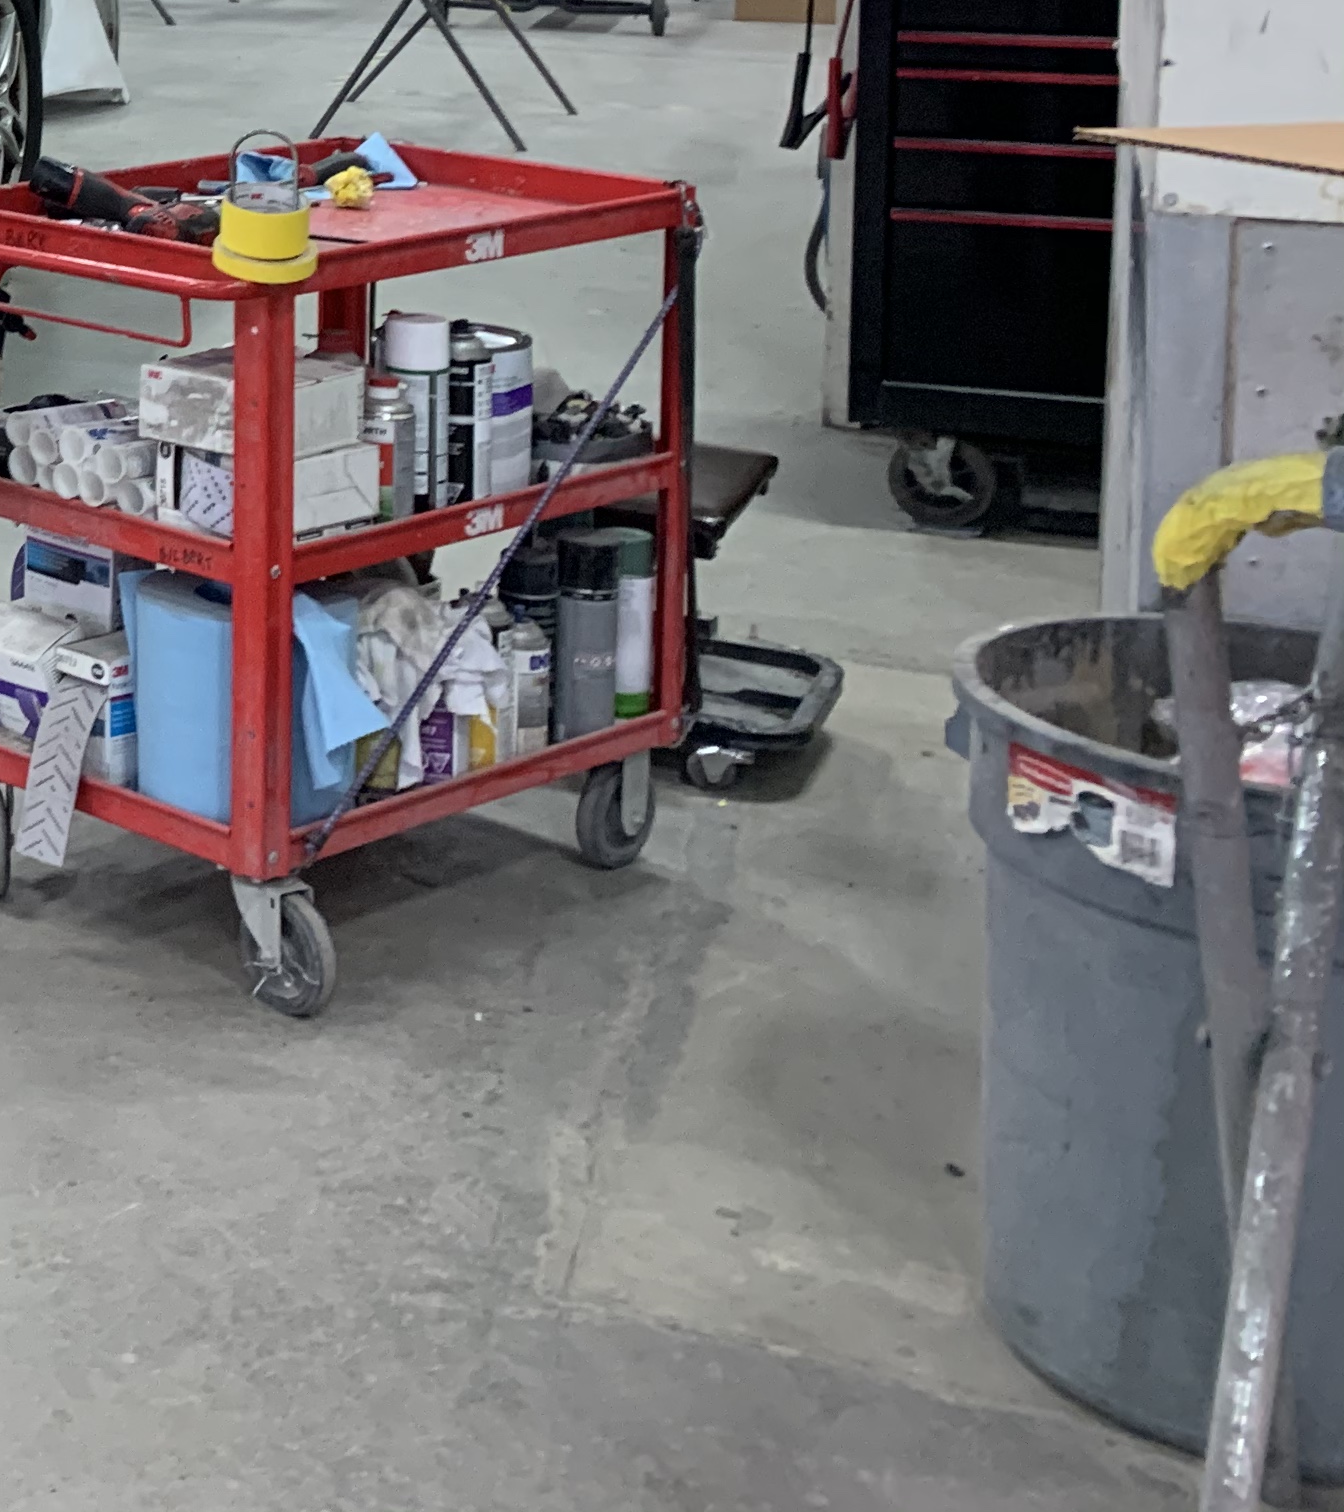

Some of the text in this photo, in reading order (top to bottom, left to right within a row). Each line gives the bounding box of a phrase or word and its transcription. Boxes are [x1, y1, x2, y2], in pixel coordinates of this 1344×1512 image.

[465, 228, 505, 262] 3M
[464, 503, 504, 537] 3M
[112, 664, 129, 678] 3M
